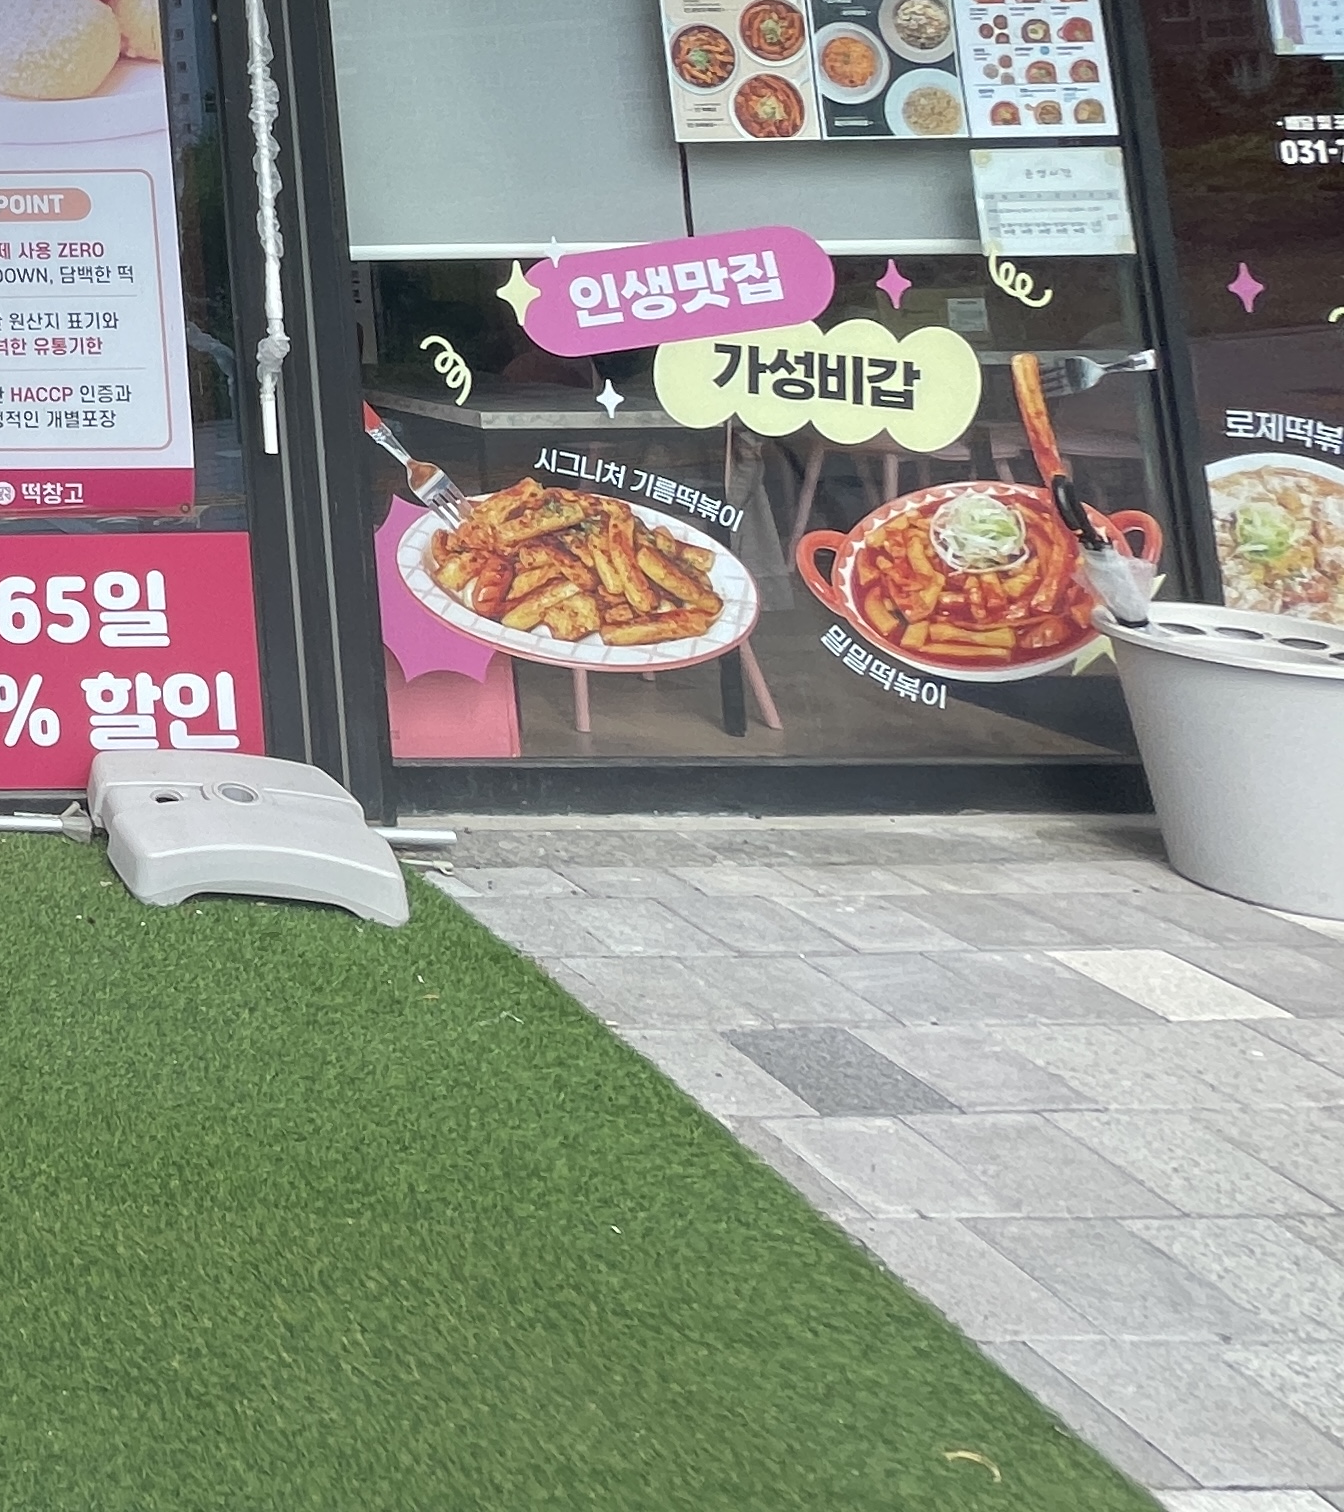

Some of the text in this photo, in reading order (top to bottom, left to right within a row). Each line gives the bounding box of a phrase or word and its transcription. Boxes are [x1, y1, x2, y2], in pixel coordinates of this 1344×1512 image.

[17, 241, 52, 261] 사용
[57, 241, 105, 259] ZERO
[59, 264, 112, 285] 담백한
[116, 264, 134, 285] 떡
[568, 249, 785, 330] 인생맛집
[8, 312, 61, 332] 원산지
[66, 311, 120, 331] 표기와
[33, 336, 104, 356] 유통기한
[712, 342, 922, 411] 가성비갑
[10, 386, 74, 404] HACCP
[79, 384, 133, 404] 인증과
[46, 409, 117, 429] 개별포장
[20, 482, 85, 506] 떡창고
[533, 446, 745, 533] 시그니처 기름떡볶이
[820, 624, 947, 710] 밀밀떡볶이
[81, 670, 242, 751] 할인
